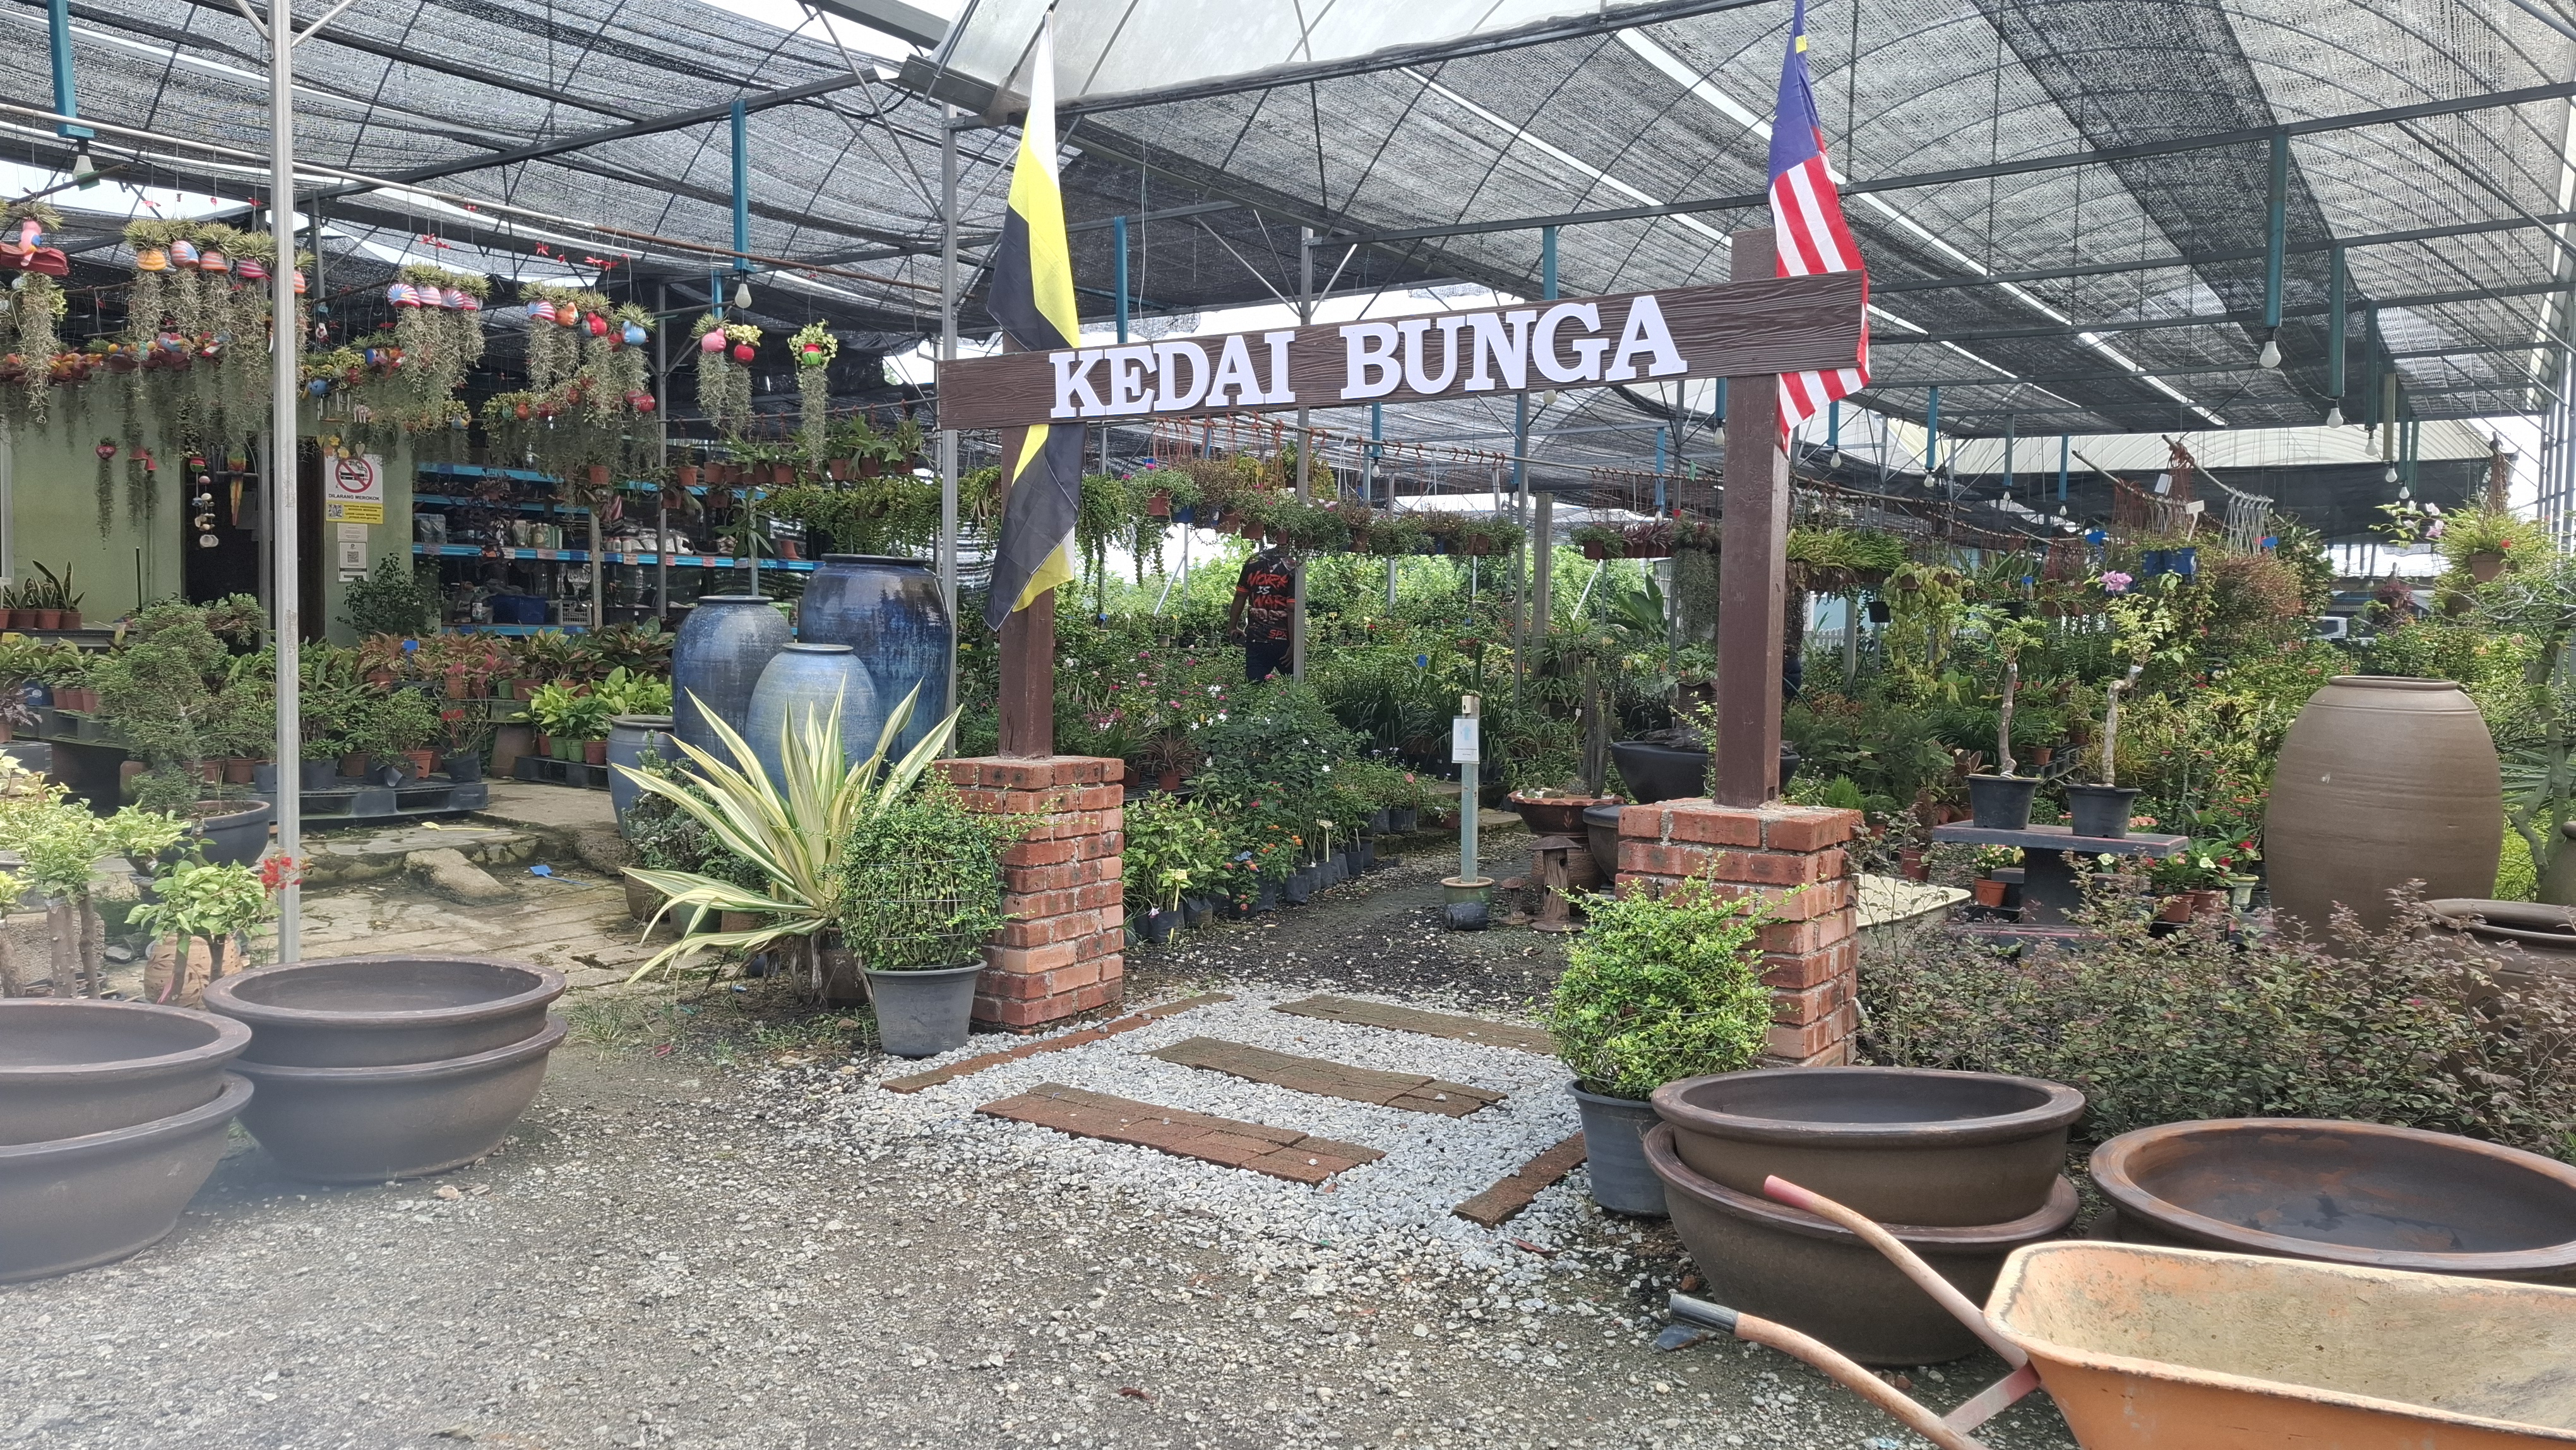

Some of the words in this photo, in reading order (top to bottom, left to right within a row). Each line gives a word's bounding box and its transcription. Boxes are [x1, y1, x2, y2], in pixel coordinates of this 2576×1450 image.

[1049, 330, 1296, 419] KEDAI
[1339, 295, 1688, 399] BUNGA
[1256, 585, 1271, 594] IS
[1268, 629, 1287, 638] SPX
